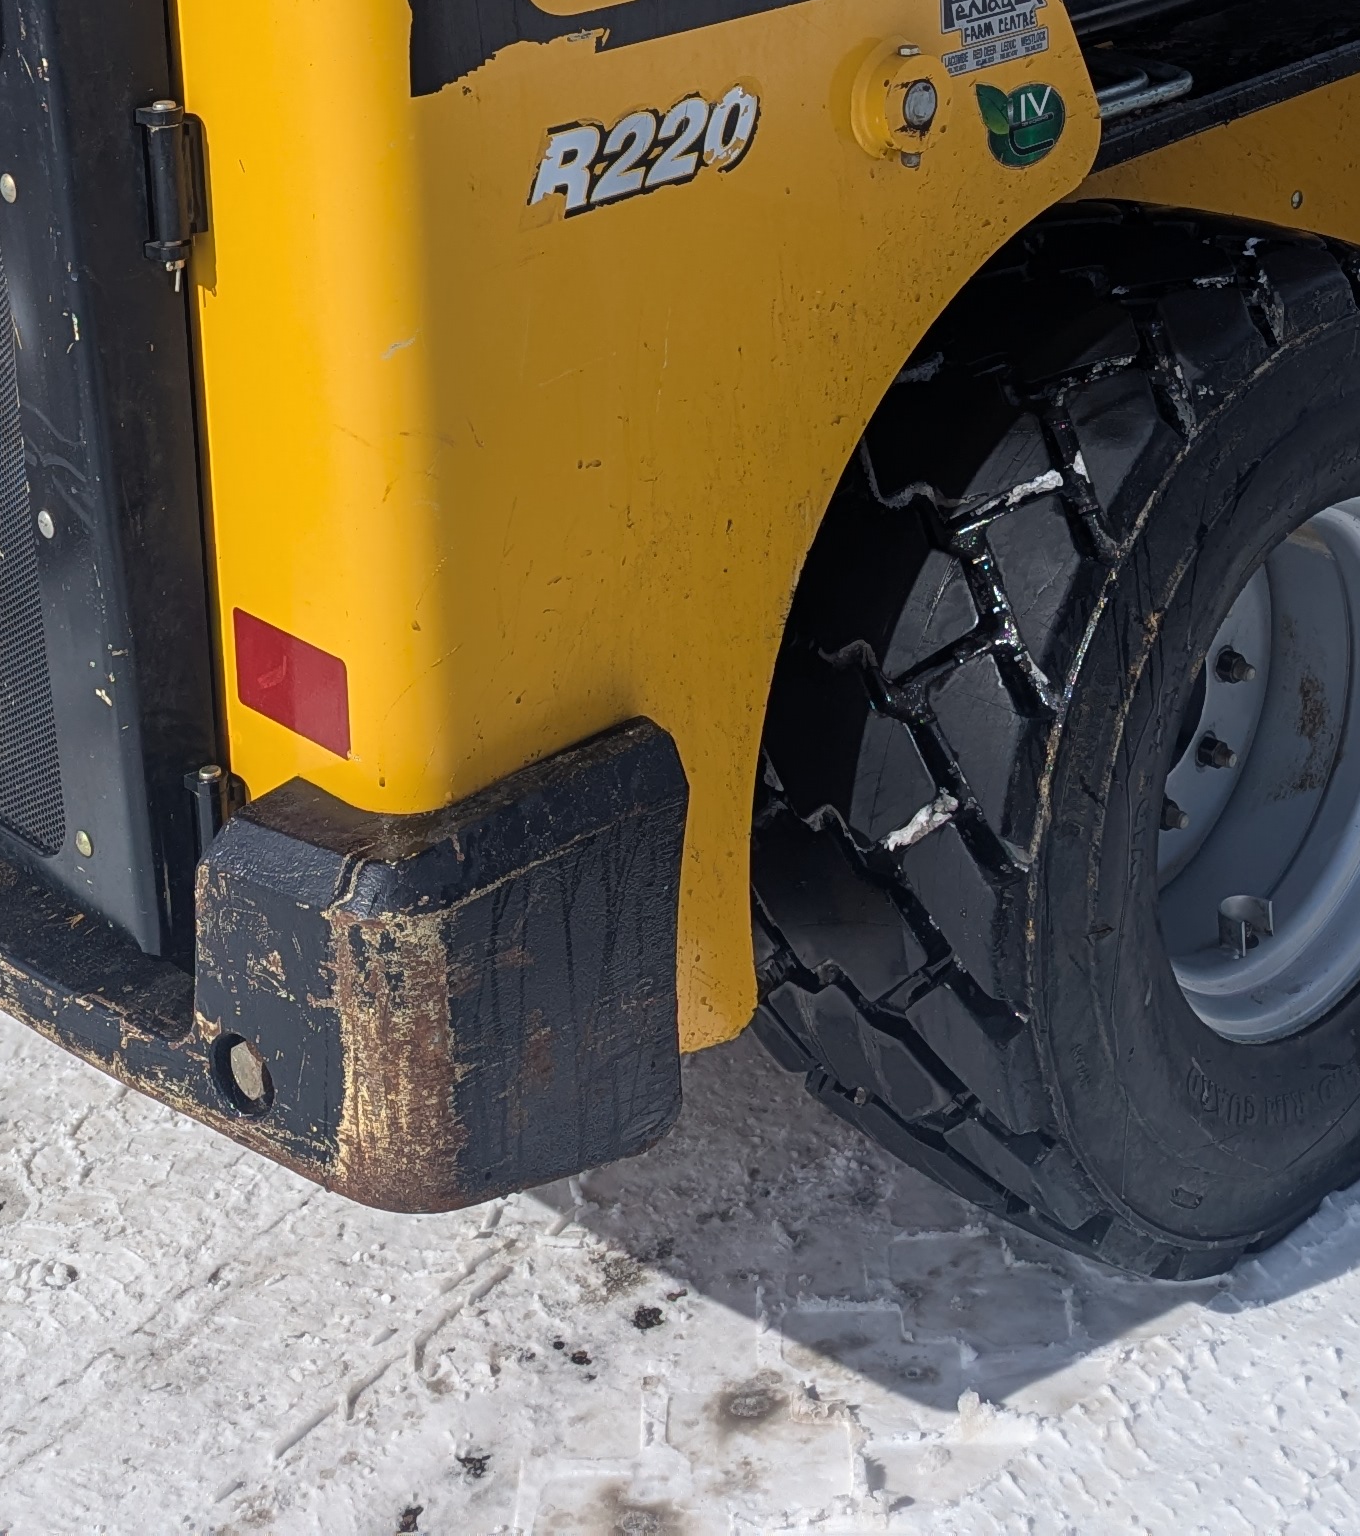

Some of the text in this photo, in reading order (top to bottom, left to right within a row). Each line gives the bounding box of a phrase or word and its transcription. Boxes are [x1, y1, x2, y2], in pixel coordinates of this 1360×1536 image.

[963, 8, 1036, 43] FARM CENTRE
[1020, 86, 1051, 123] IV
[528, 86, 761, 219] R220
